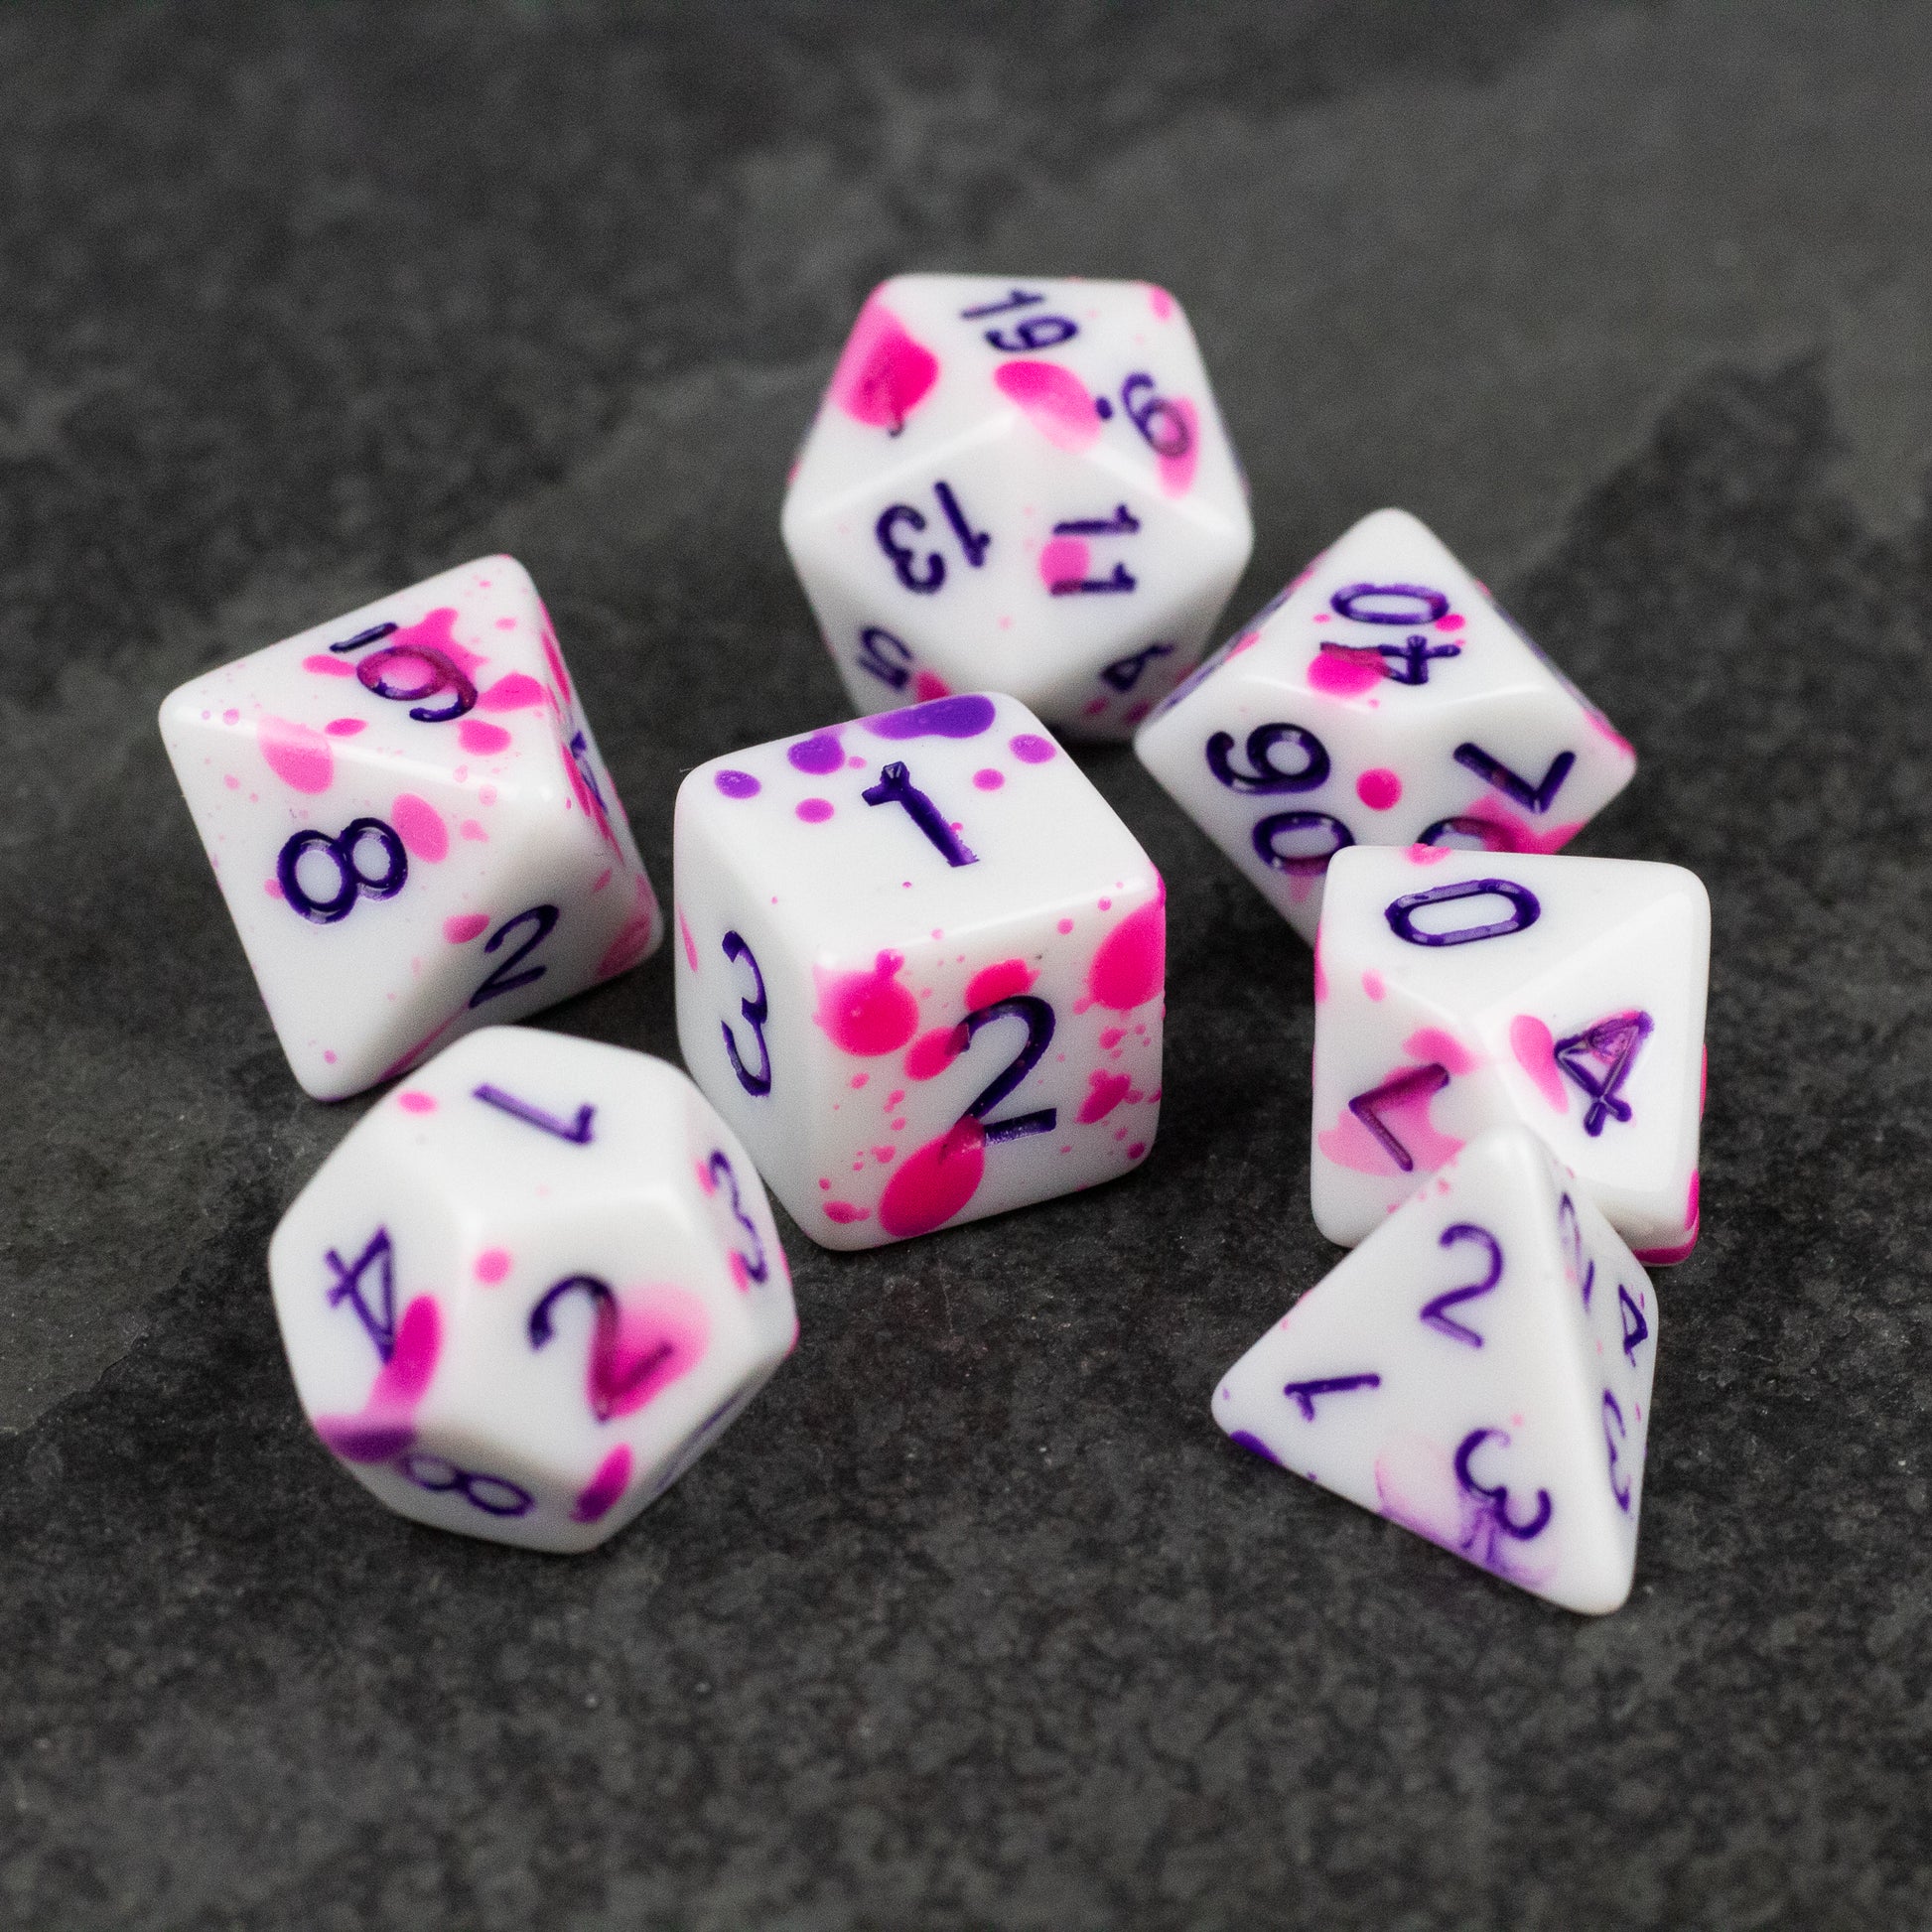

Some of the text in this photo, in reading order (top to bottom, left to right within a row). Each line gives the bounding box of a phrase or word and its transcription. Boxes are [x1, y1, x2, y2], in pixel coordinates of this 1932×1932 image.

[960, 288, 1079, 352] 19
[876, 481, 991, 596] 13
[1048, 503, 1141, 597] 11
[1319, 583, 1462, 687] 40
[862, 760, 979, 867] 1
[1205, 722, 1355, 876] 90
[276, 817, 409, 924] 8
[1384, 878, 1542, 947] 0
[468, 904, 561, 1009] 2
[721, 929, 772, 1097] 3
[473, 1082, 597, 1147] 1
[938, 995, 1057, 1165] 2
[1554, 1010, 1655, 1139] 4
[323, 1222, 395, 1364] 4
[1420, 1222, 1504, 1349] 2
[528, 1273, 675, 1422] 2
[1283, 1372, 1382, 1422] 1
[400, 1452, 535, 1519] 8
[1453, 1427, 1553, 1541] 3
